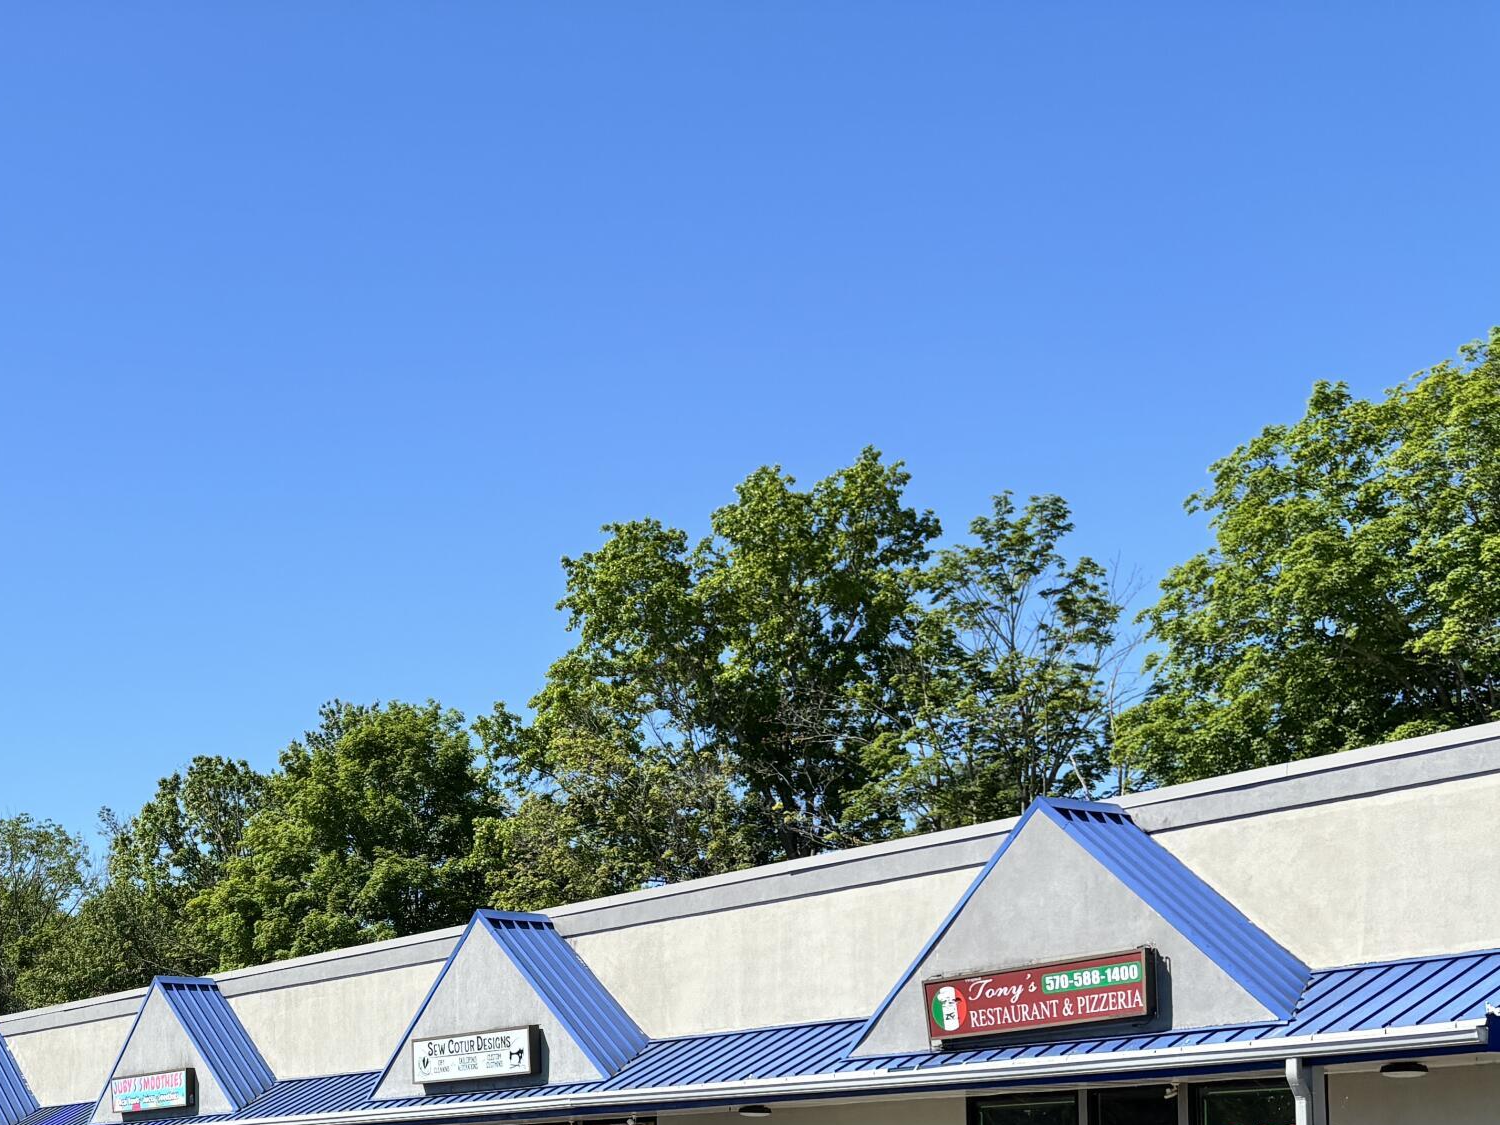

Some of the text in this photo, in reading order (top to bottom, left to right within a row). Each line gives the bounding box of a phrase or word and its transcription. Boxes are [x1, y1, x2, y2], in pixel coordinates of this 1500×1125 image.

[967, 973, 1038, 1003] Tony's
[1044, 964, 1139, 991] 570-588-1400
[969, 988, 1144, 1028] RESTAURANT & PIZZERIA
[447, 1039, 475, 1054] COTUR
[476, 1035, 511, 1051] DESIGNS
[139, 1072, 183, 1092] SMOOTHIES
